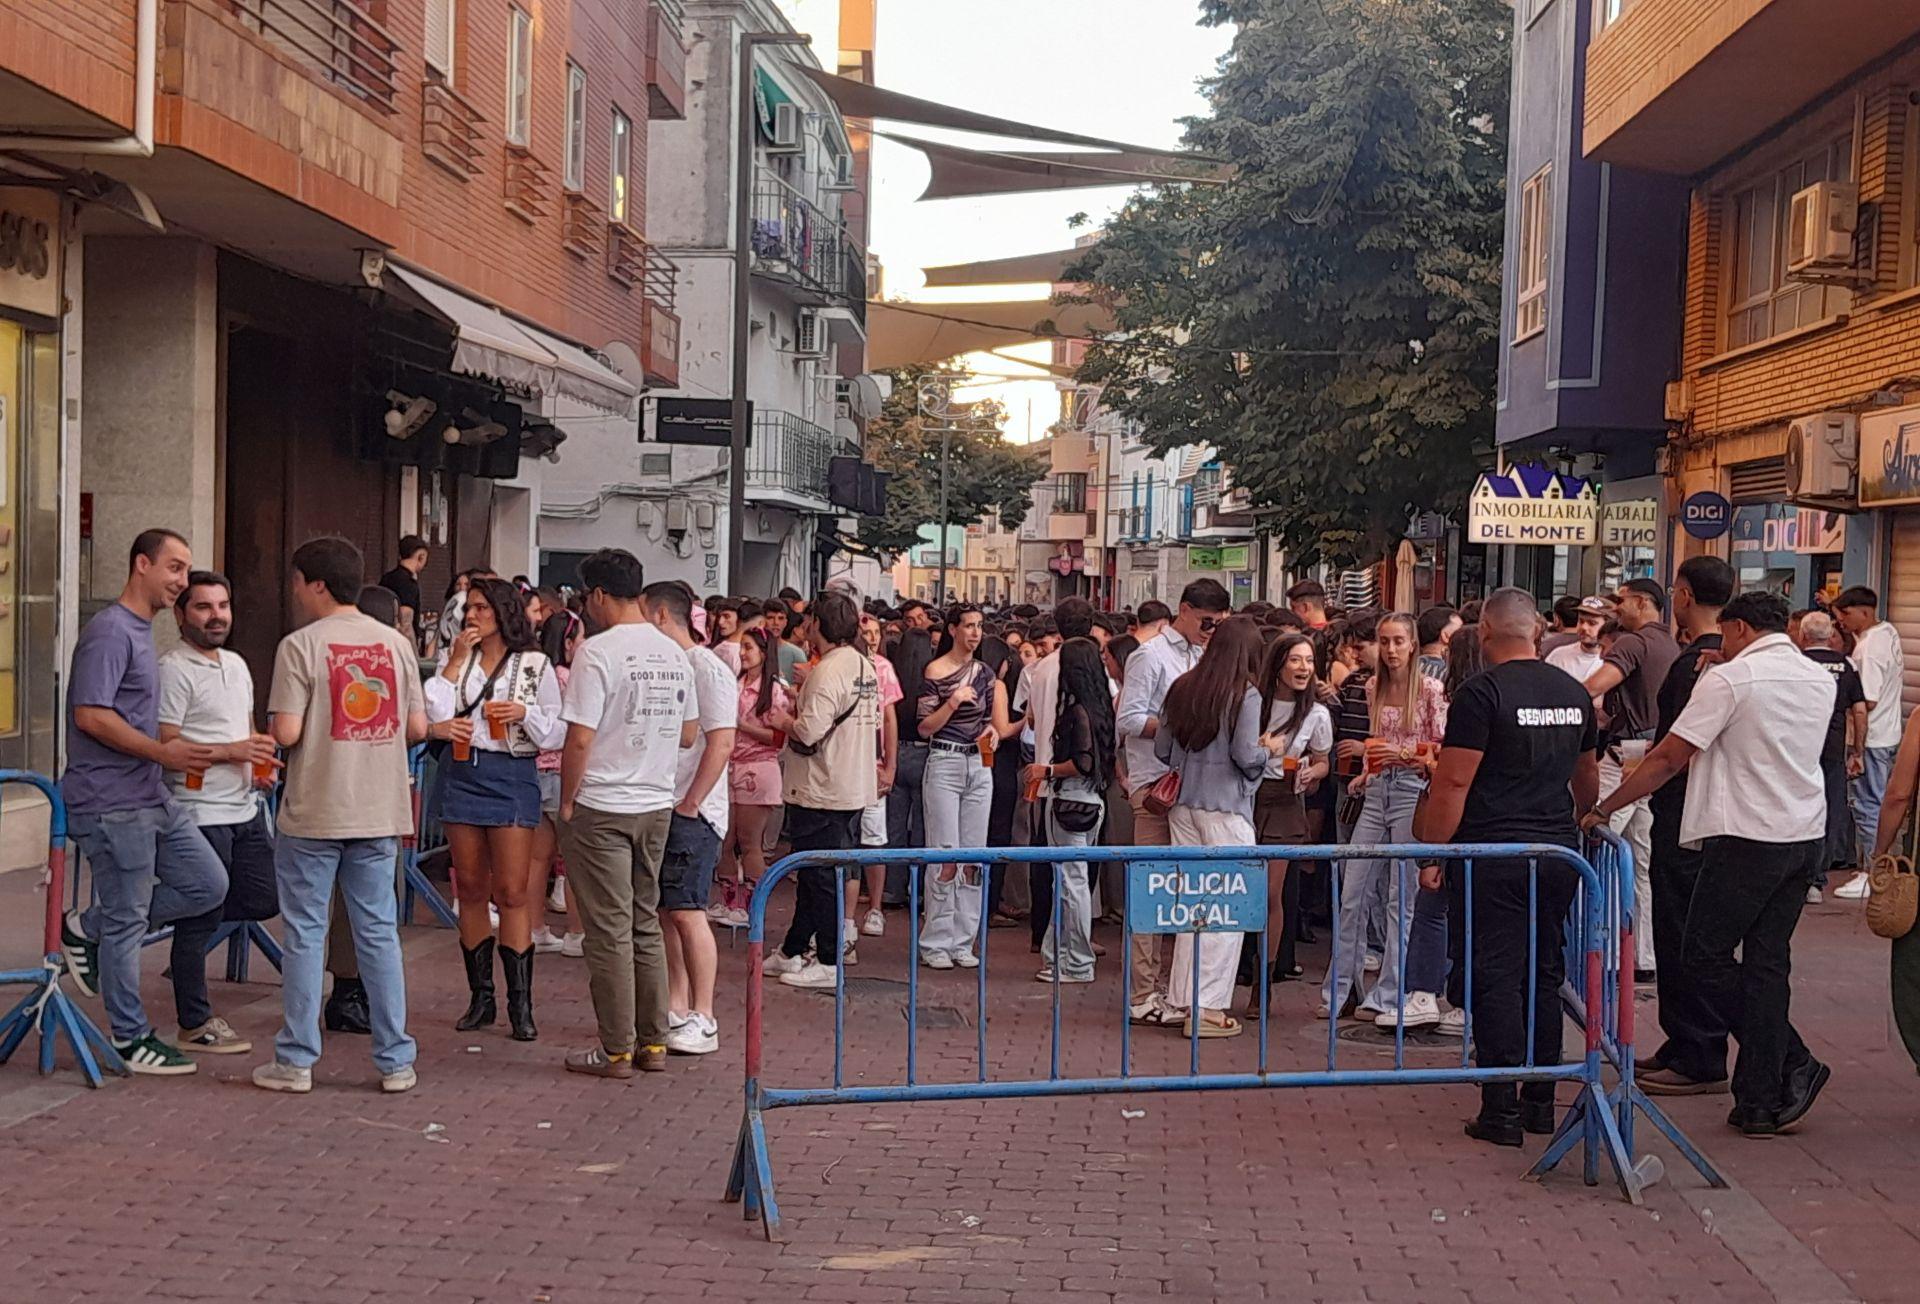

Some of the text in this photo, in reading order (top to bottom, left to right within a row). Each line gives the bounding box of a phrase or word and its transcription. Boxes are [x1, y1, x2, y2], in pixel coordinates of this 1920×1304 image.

[1474, 502, 1593, 519] INMOBILIARIA
[1687, 505, 1723, 519] DIGI
[1481, 524, 1585, 540] DEL MONTE
[630, 671, 654, 681] GOOD
[1517, 708, 1583, 726] SEGURIDAD
[1148, 872, 1248, 895] POLICIA
[1157, 903, 1239, 927] LOCAL
